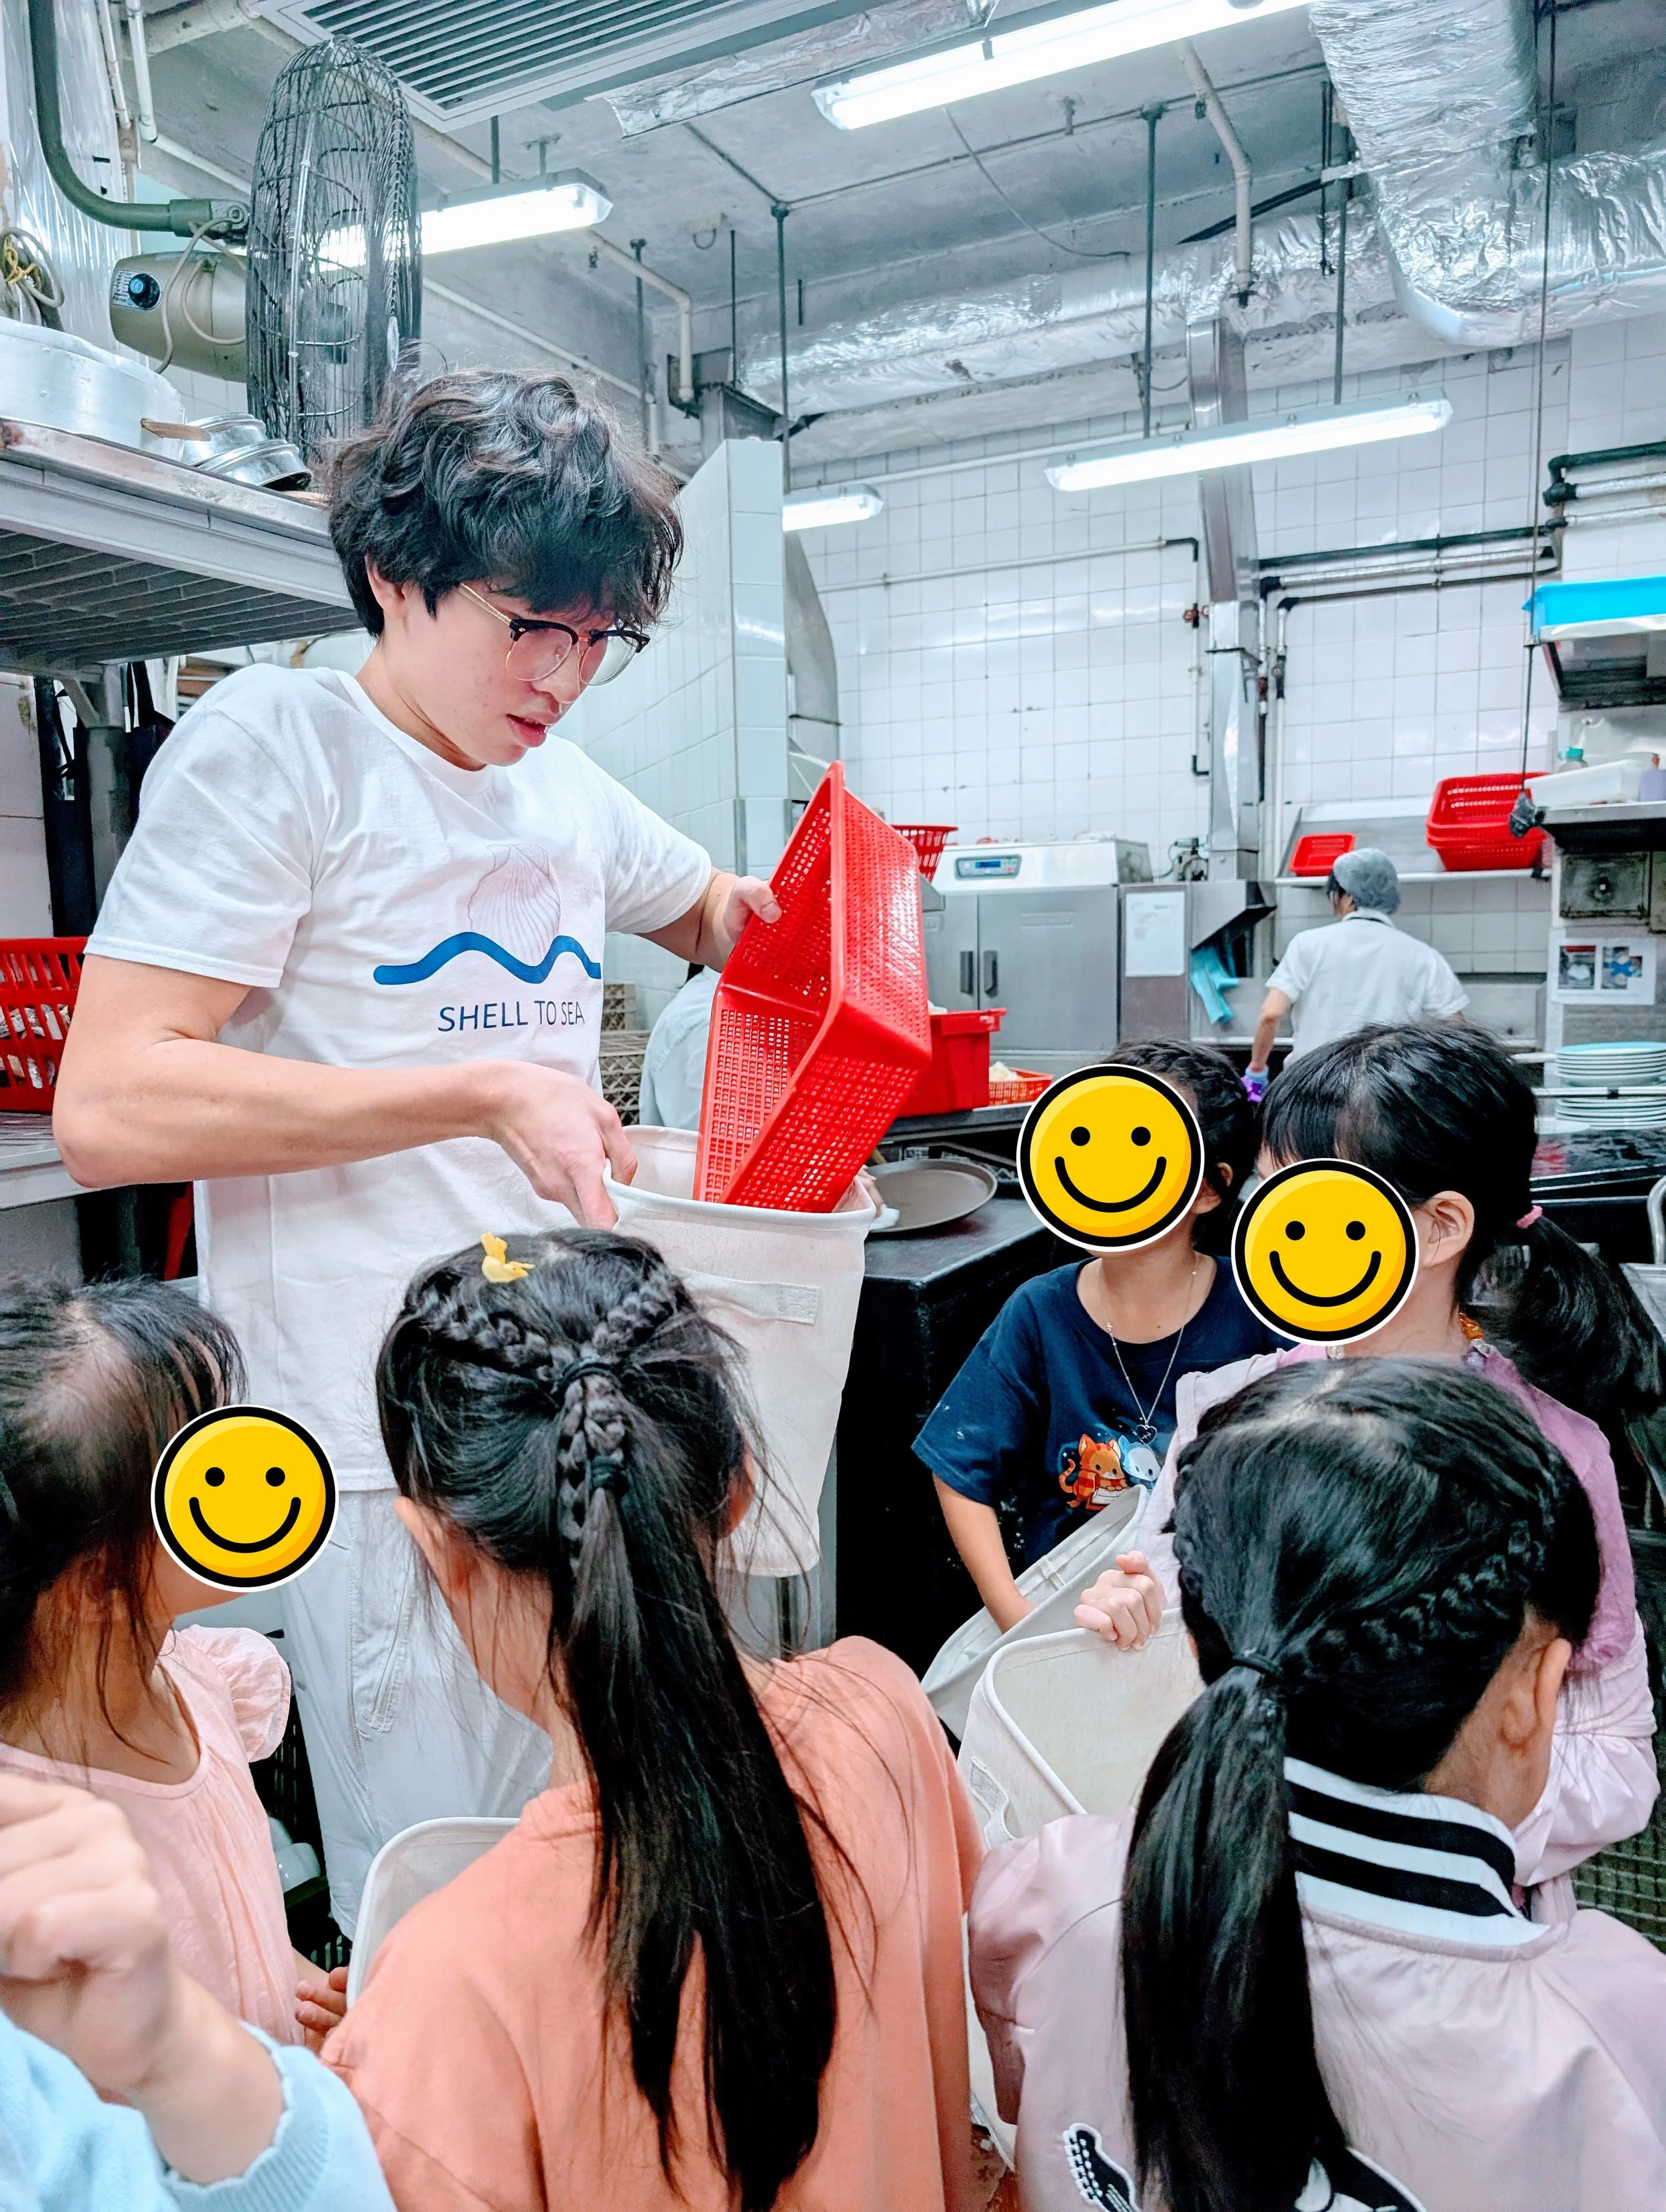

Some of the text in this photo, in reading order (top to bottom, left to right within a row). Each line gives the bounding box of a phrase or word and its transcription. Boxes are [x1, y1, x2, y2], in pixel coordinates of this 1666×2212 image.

[438, 1000, 585, 1032] SHELL TO SEA
